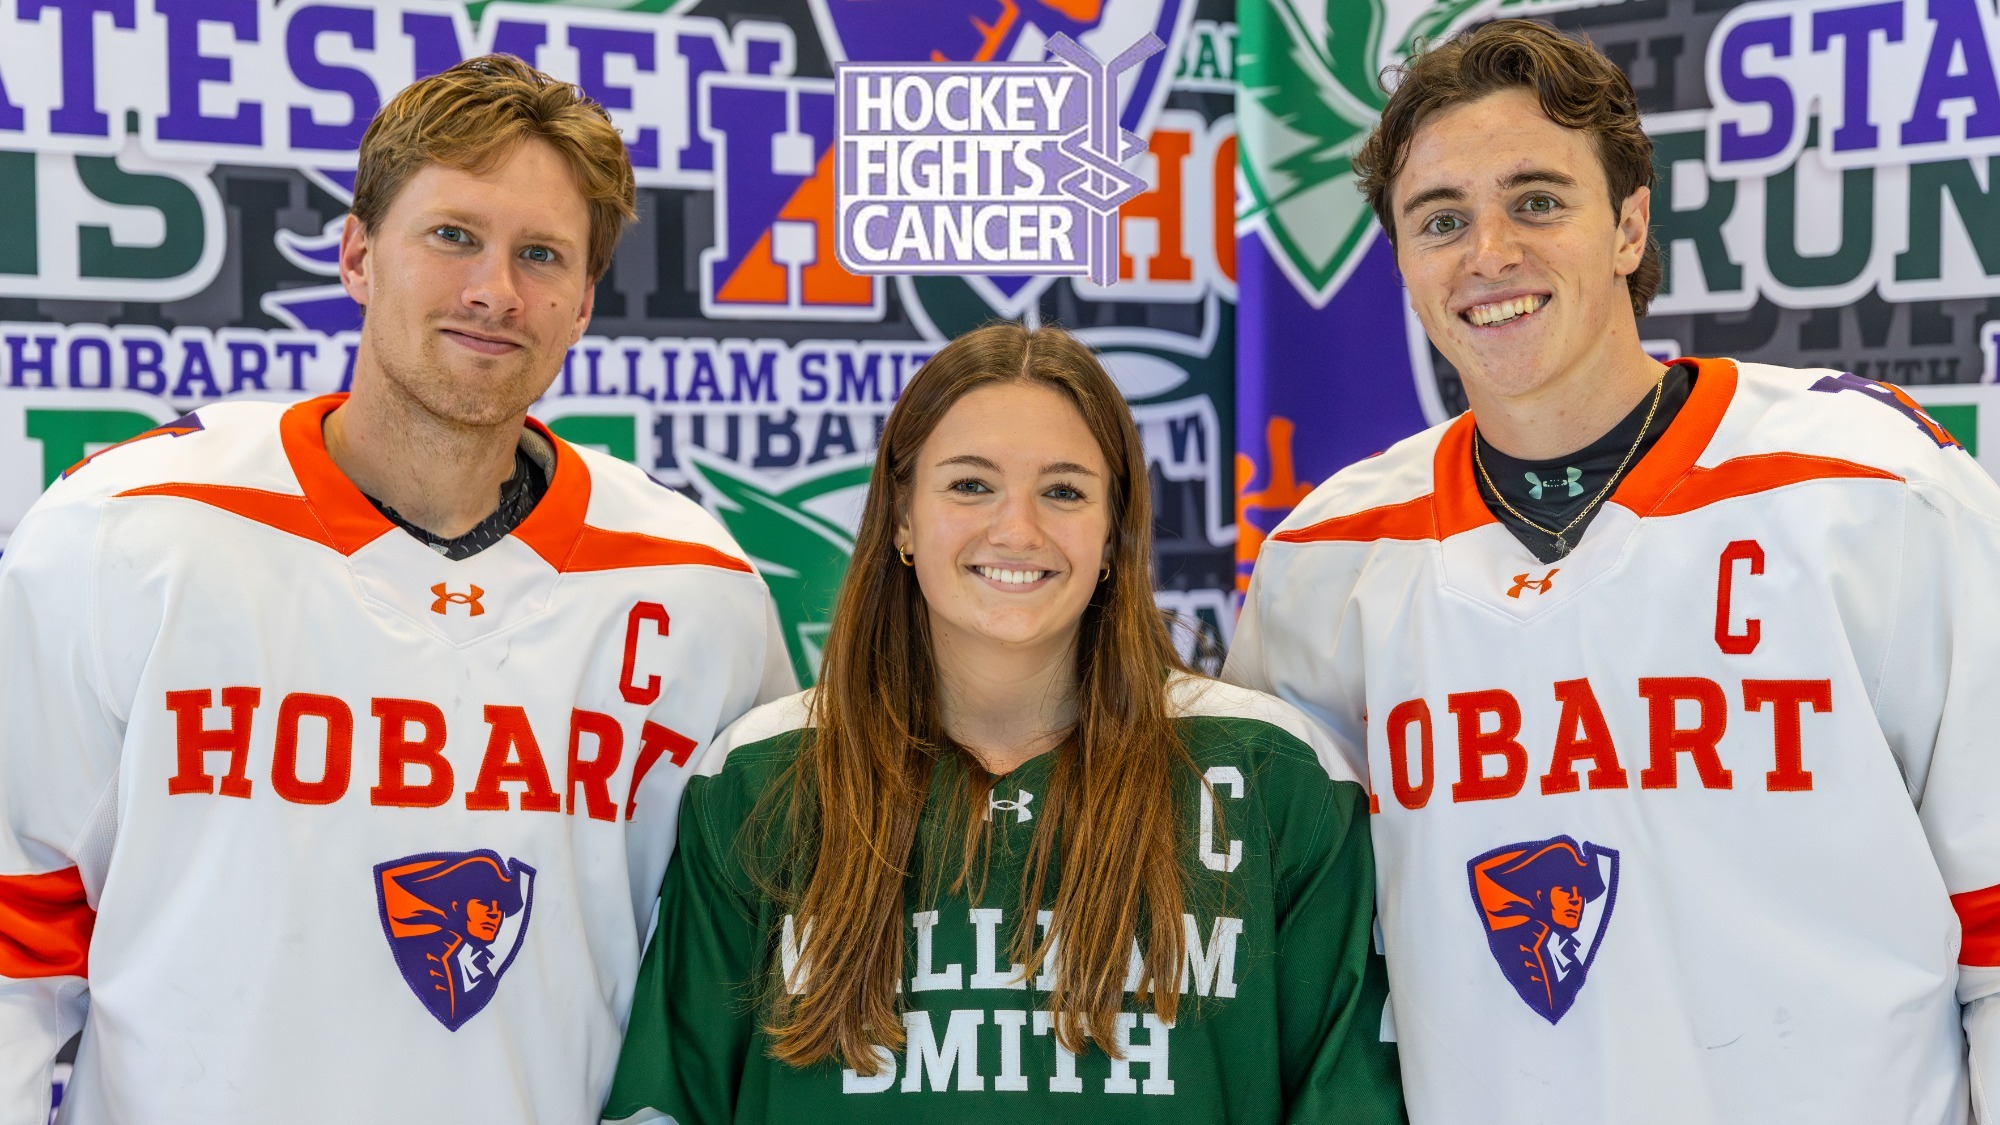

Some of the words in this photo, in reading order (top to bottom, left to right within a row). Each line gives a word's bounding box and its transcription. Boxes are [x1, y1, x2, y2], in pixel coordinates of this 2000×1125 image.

[5, 335, 318, 397] HOBART
[558, 348, 779, 403] ILLIAM
[1714, 539, 1765, 655] C
[618, 600, 671, 706] C
[165, 686, 698, 822] HOBART
[1364, 676, 1833, 815] OBART
[1199, 766, 1244, 873] C
